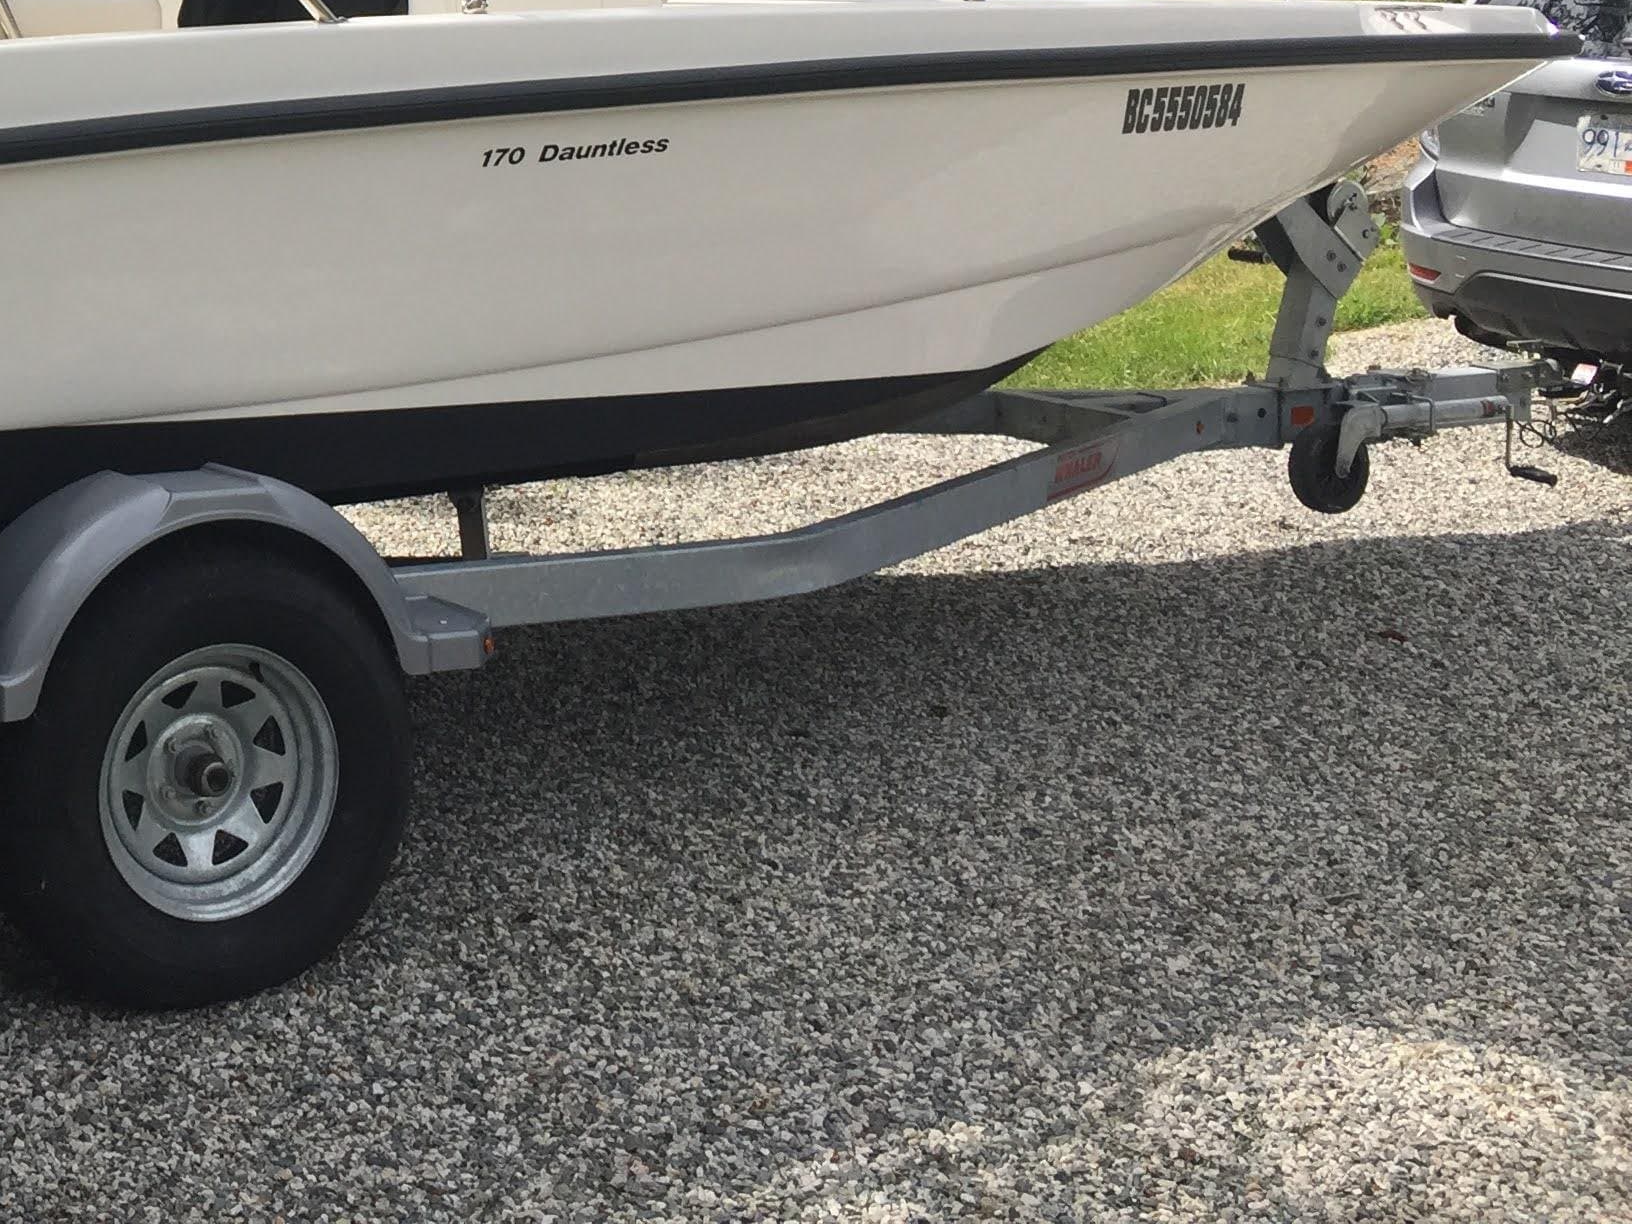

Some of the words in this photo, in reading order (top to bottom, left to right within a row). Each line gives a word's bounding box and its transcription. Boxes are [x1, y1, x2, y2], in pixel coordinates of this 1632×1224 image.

[1122, 83, 1245, 134] BC5550584
[482, 146, 525, 167] 170
[538, 137, 669, 162] Dauntless
